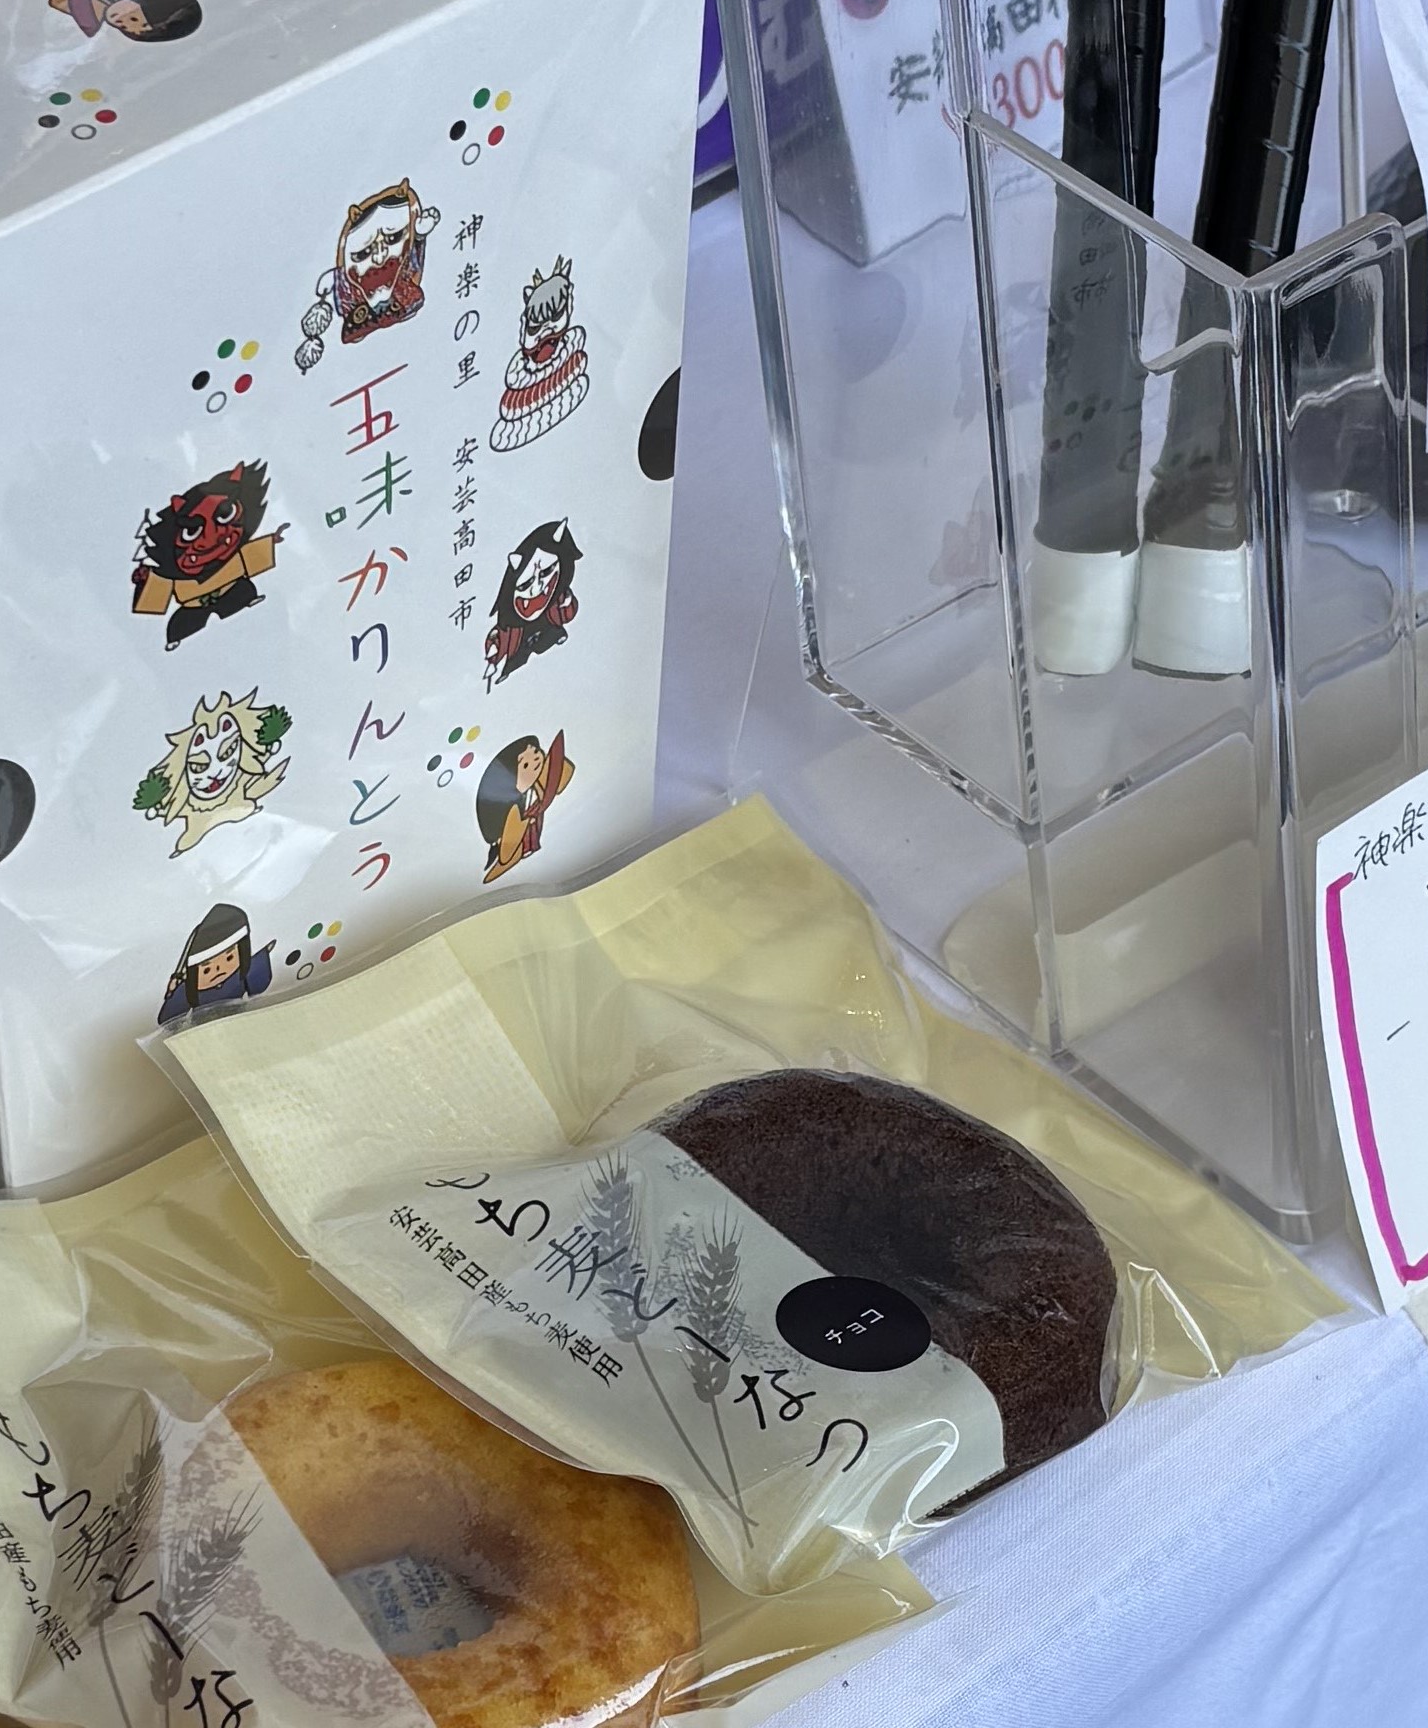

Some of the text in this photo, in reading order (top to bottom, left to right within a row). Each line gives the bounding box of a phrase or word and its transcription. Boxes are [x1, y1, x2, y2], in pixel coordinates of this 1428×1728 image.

[446, 212, 486, 634] 神楽の里 安芸高田市
[324, 361, 414, 895] 五味かりんとう
[387, 1204, 625, 1390] 安芸高田産もち麦使用
[825, 1307, 885, 1347] チョコ
